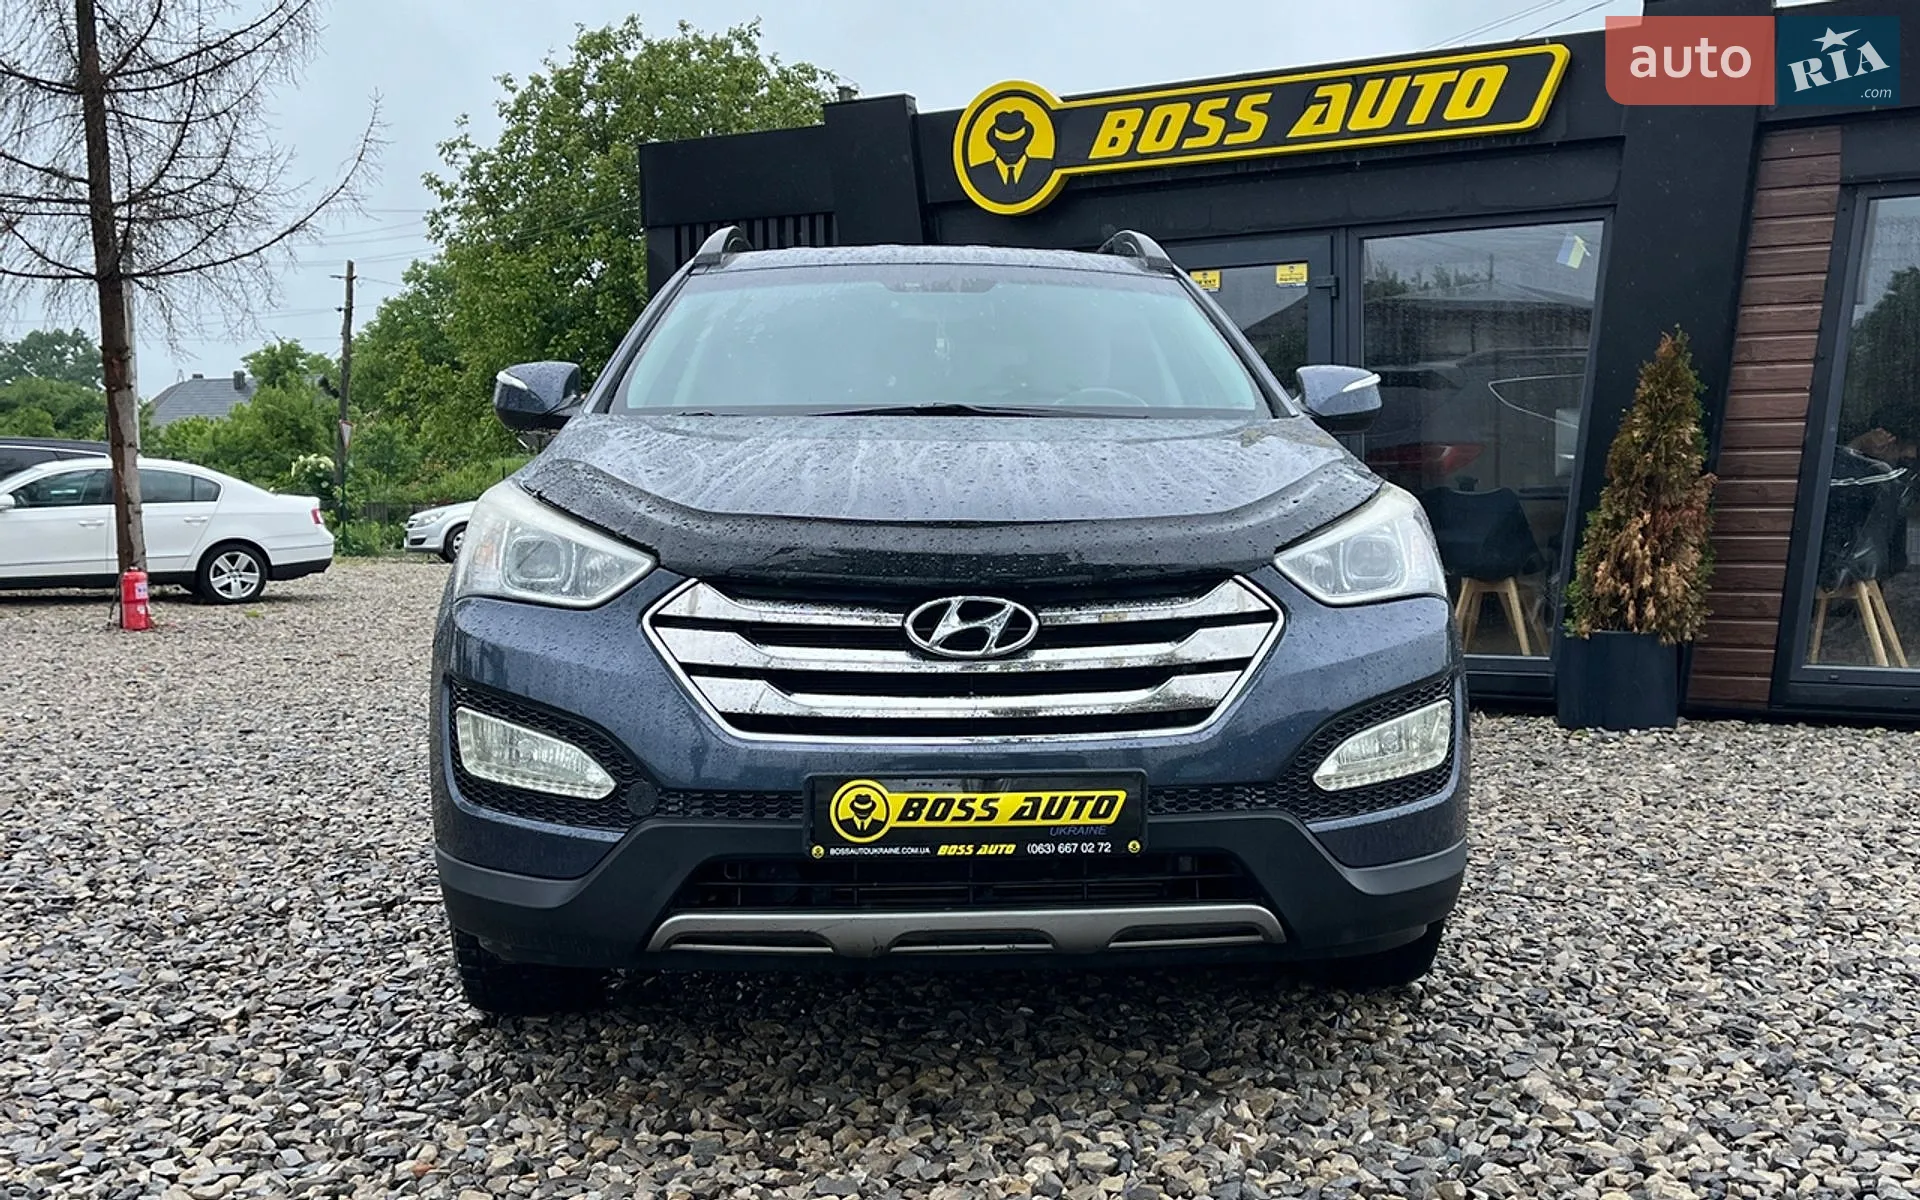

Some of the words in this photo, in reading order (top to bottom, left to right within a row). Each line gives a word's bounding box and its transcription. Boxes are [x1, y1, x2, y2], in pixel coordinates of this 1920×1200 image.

[1089, 91, 1272, 159] BOSS
[1287, 64, 1509, 138] AUTO
[898, 795, 1000, 822] BOSS
[1011, 795, 1120, 820] AUTO
[1049, 825, 1108, 837] UKRAINE
[829, 846, 931, 856] BOSSAUTOUKRAINE.COM.UA
[937, 844, 975, 856] BOSS
[976, 844, 1016, 855] AUTO
[1027, 842, 1055, 855] (063)
[1058, 842, 1079, 854] 667
[1080, 842, 1095, 854] 02
[1096, 842, 1112, 853] 72
